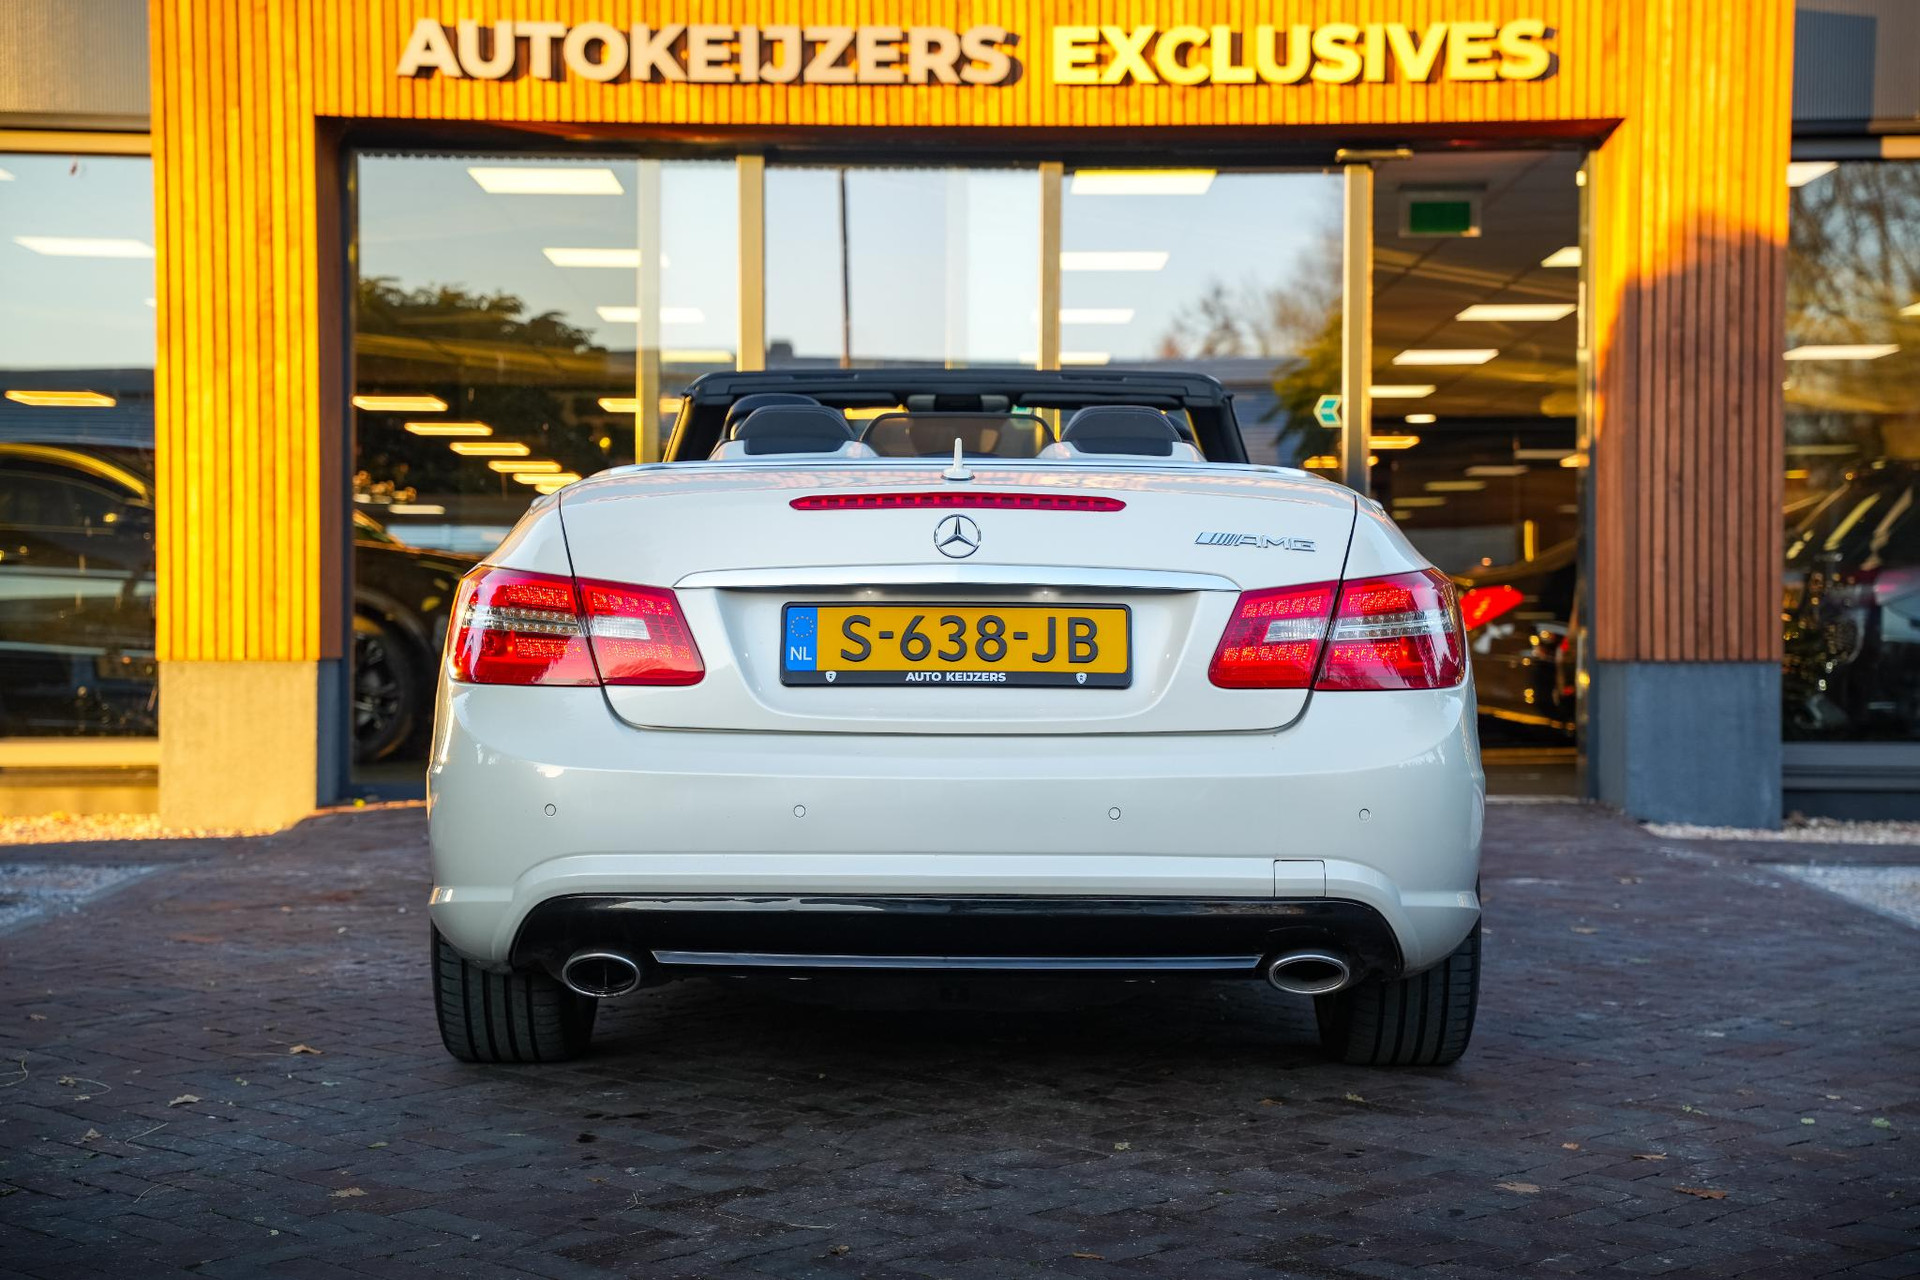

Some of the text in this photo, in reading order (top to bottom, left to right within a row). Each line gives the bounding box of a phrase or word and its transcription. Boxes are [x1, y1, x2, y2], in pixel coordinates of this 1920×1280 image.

[397, 19, 1552, 85] AUTOKEIJZERS EXCLUSIVES
[789, 646, 813, 662] NL
[840, 614, 1100, 664] S-638-JB
[905, 672, 1007, 684] AUTO KEIJZERS
